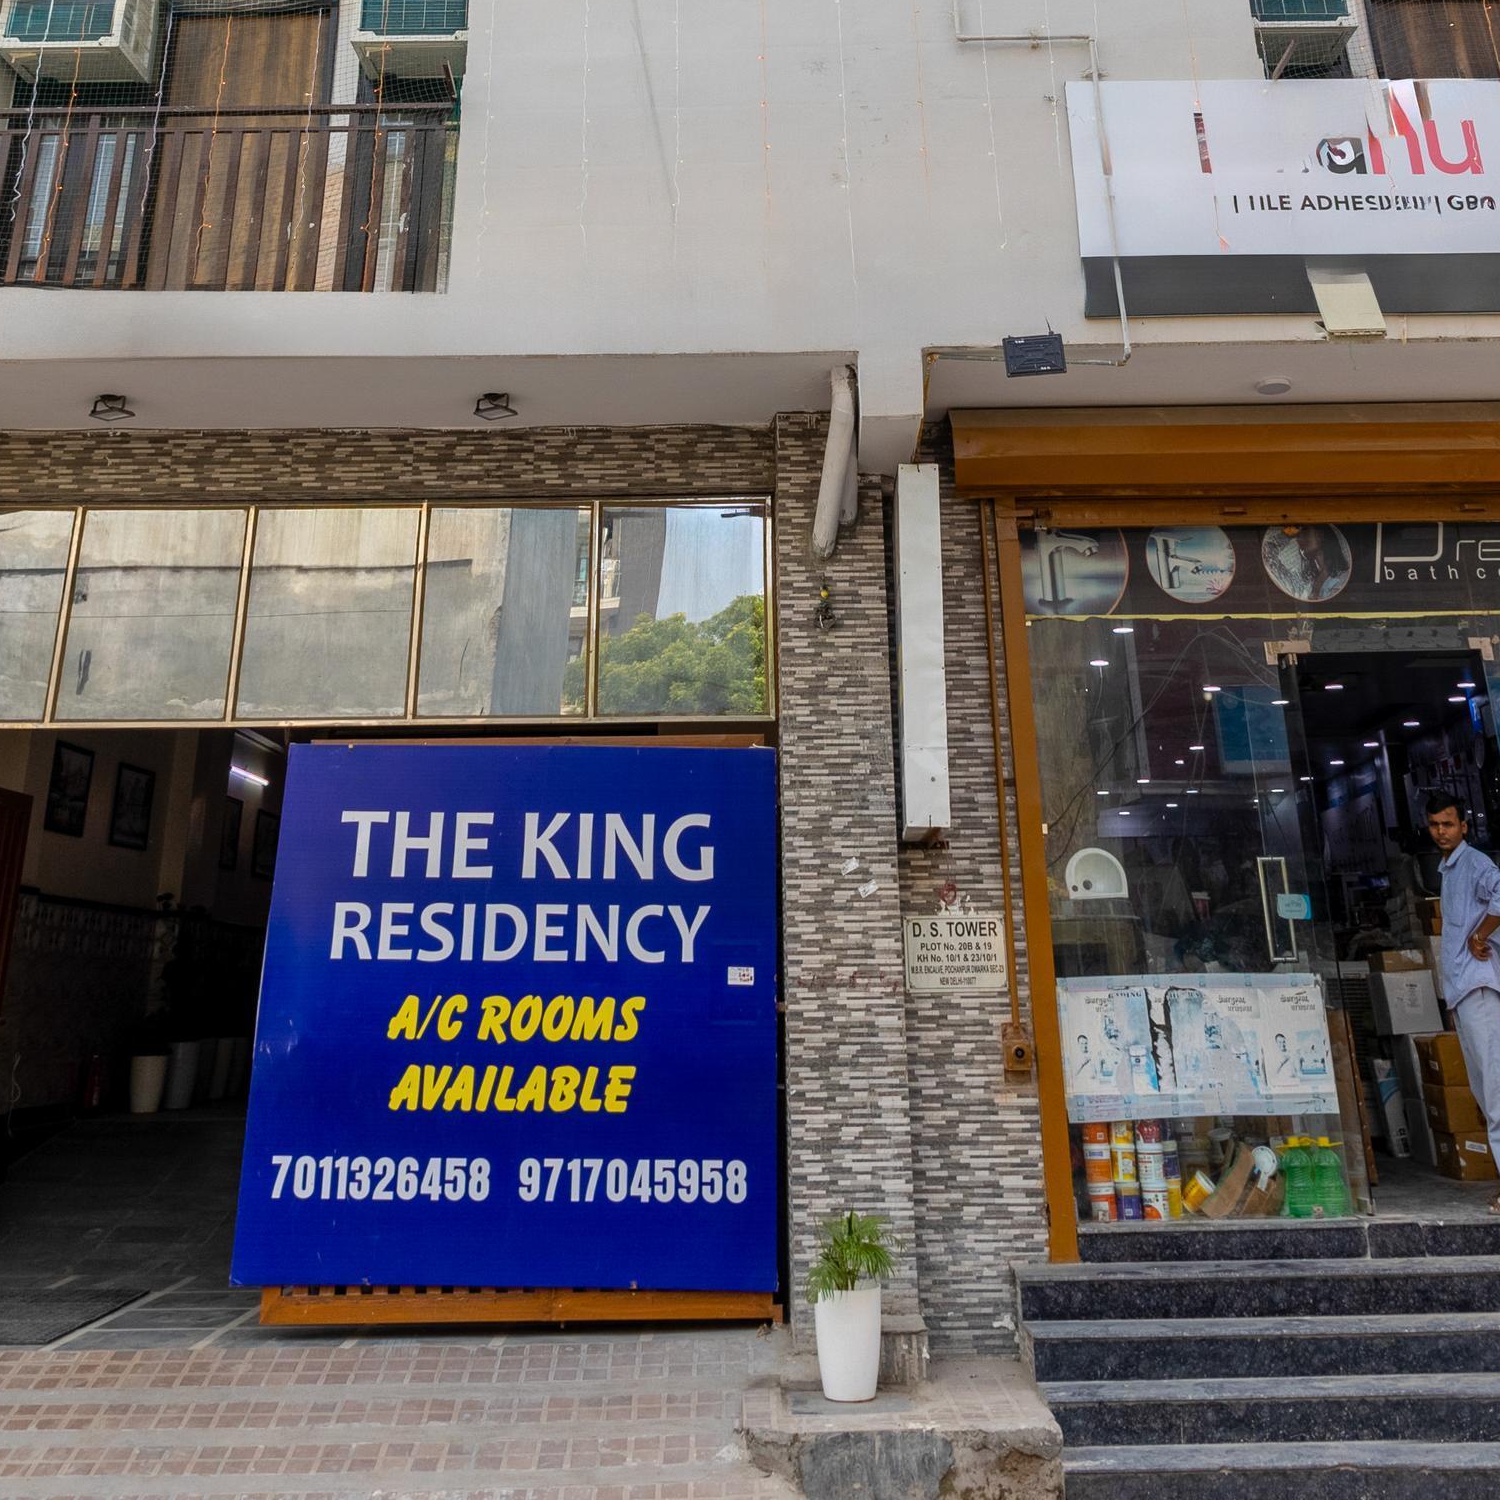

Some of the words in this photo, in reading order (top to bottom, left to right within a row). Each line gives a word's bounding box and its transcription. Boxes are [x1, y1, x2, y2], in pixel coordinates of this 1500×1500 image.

[1384, 566, 1459, 581] bath
[341, 810, 495, 878] THE
[521, 811, 715, 881] KING
[330, 901, 712, 962] RESIDENCY
[921, 942, 941, 951] PLOT
[983, 942, 992, 950] 19
[946, 921, 998, 937] TOWER
[387, 994, 469, 1041] A/C
[477, 994, 646, 1043] ROOMS
[388, 1064, 636, 1112] AVAILABLE
[271, 1155, 491, 1201] 7011326458
[518, 1158, 748, 1203] 9717045958
